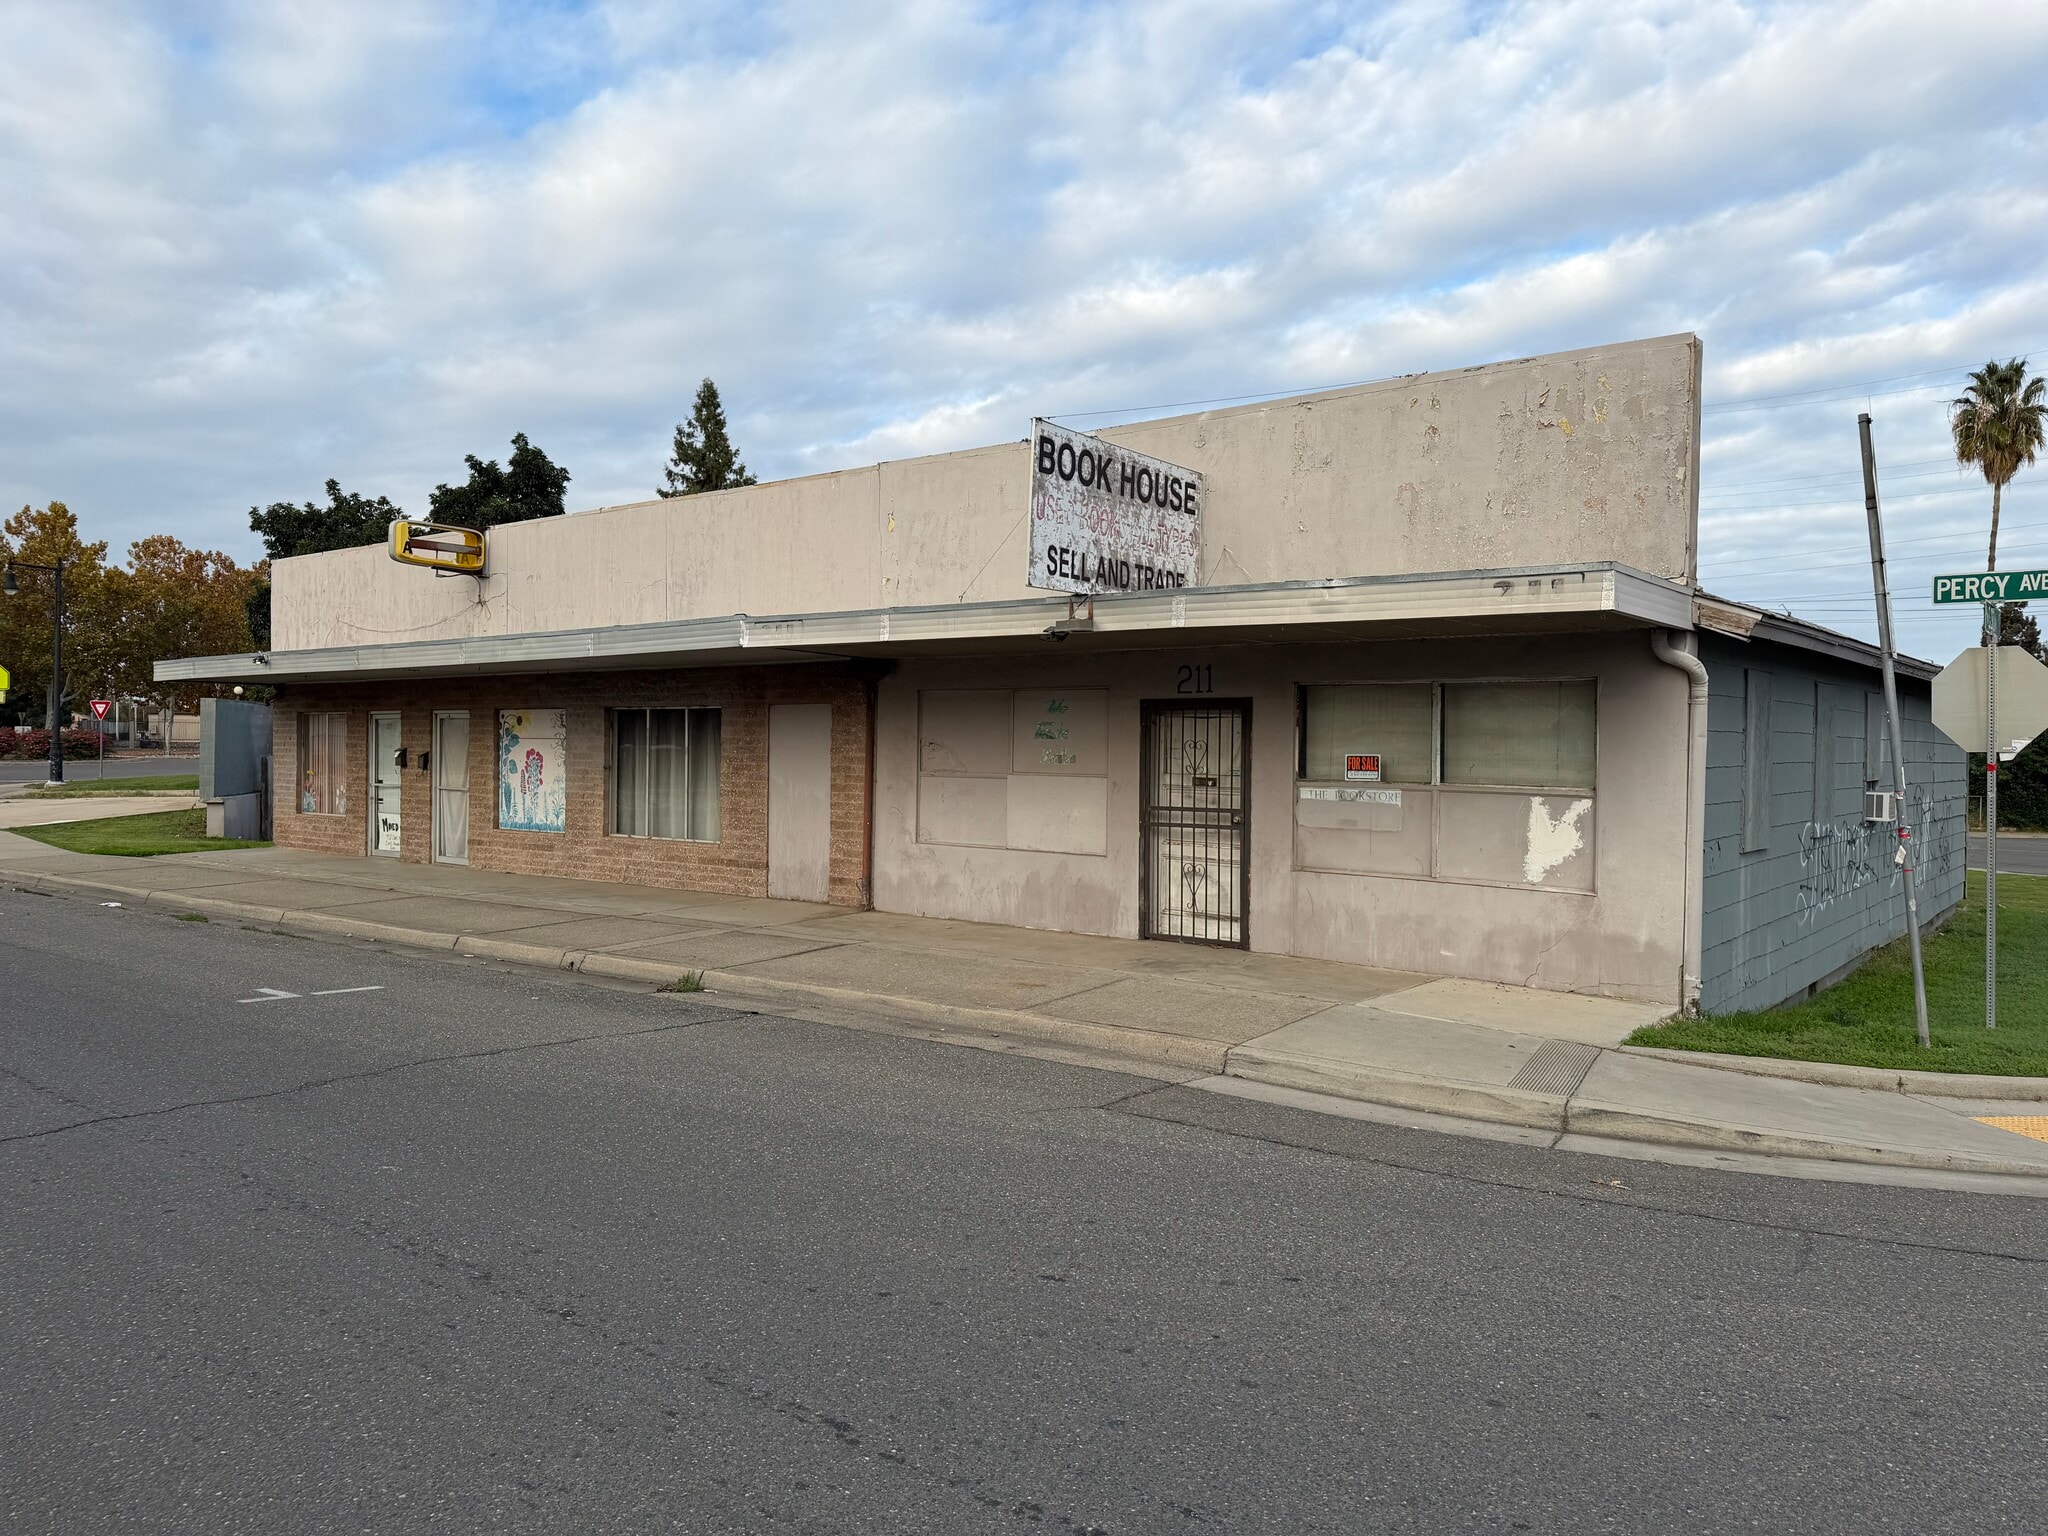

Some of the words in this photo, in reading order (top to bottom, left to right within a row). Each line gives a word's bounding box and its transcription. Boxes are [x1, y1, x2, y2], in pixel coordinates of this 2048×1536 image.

[1038, 435, 1113, 494] BOOK
[1120, 462, 1196, 515] HOUSE
[1046, 544, 1091, 582] SELL
[1096, 557, 1130, 589] AND
[1936, 575, 2011, 601] PERCY
[2018, 572, 2048, 592] AVE
[1177, 663, 1214, 694] 211
[1347, 757, 1361, 771] FOR
[1361, 757, 1379, 771] SALE
[1309, 789, 1328, 800] THE
